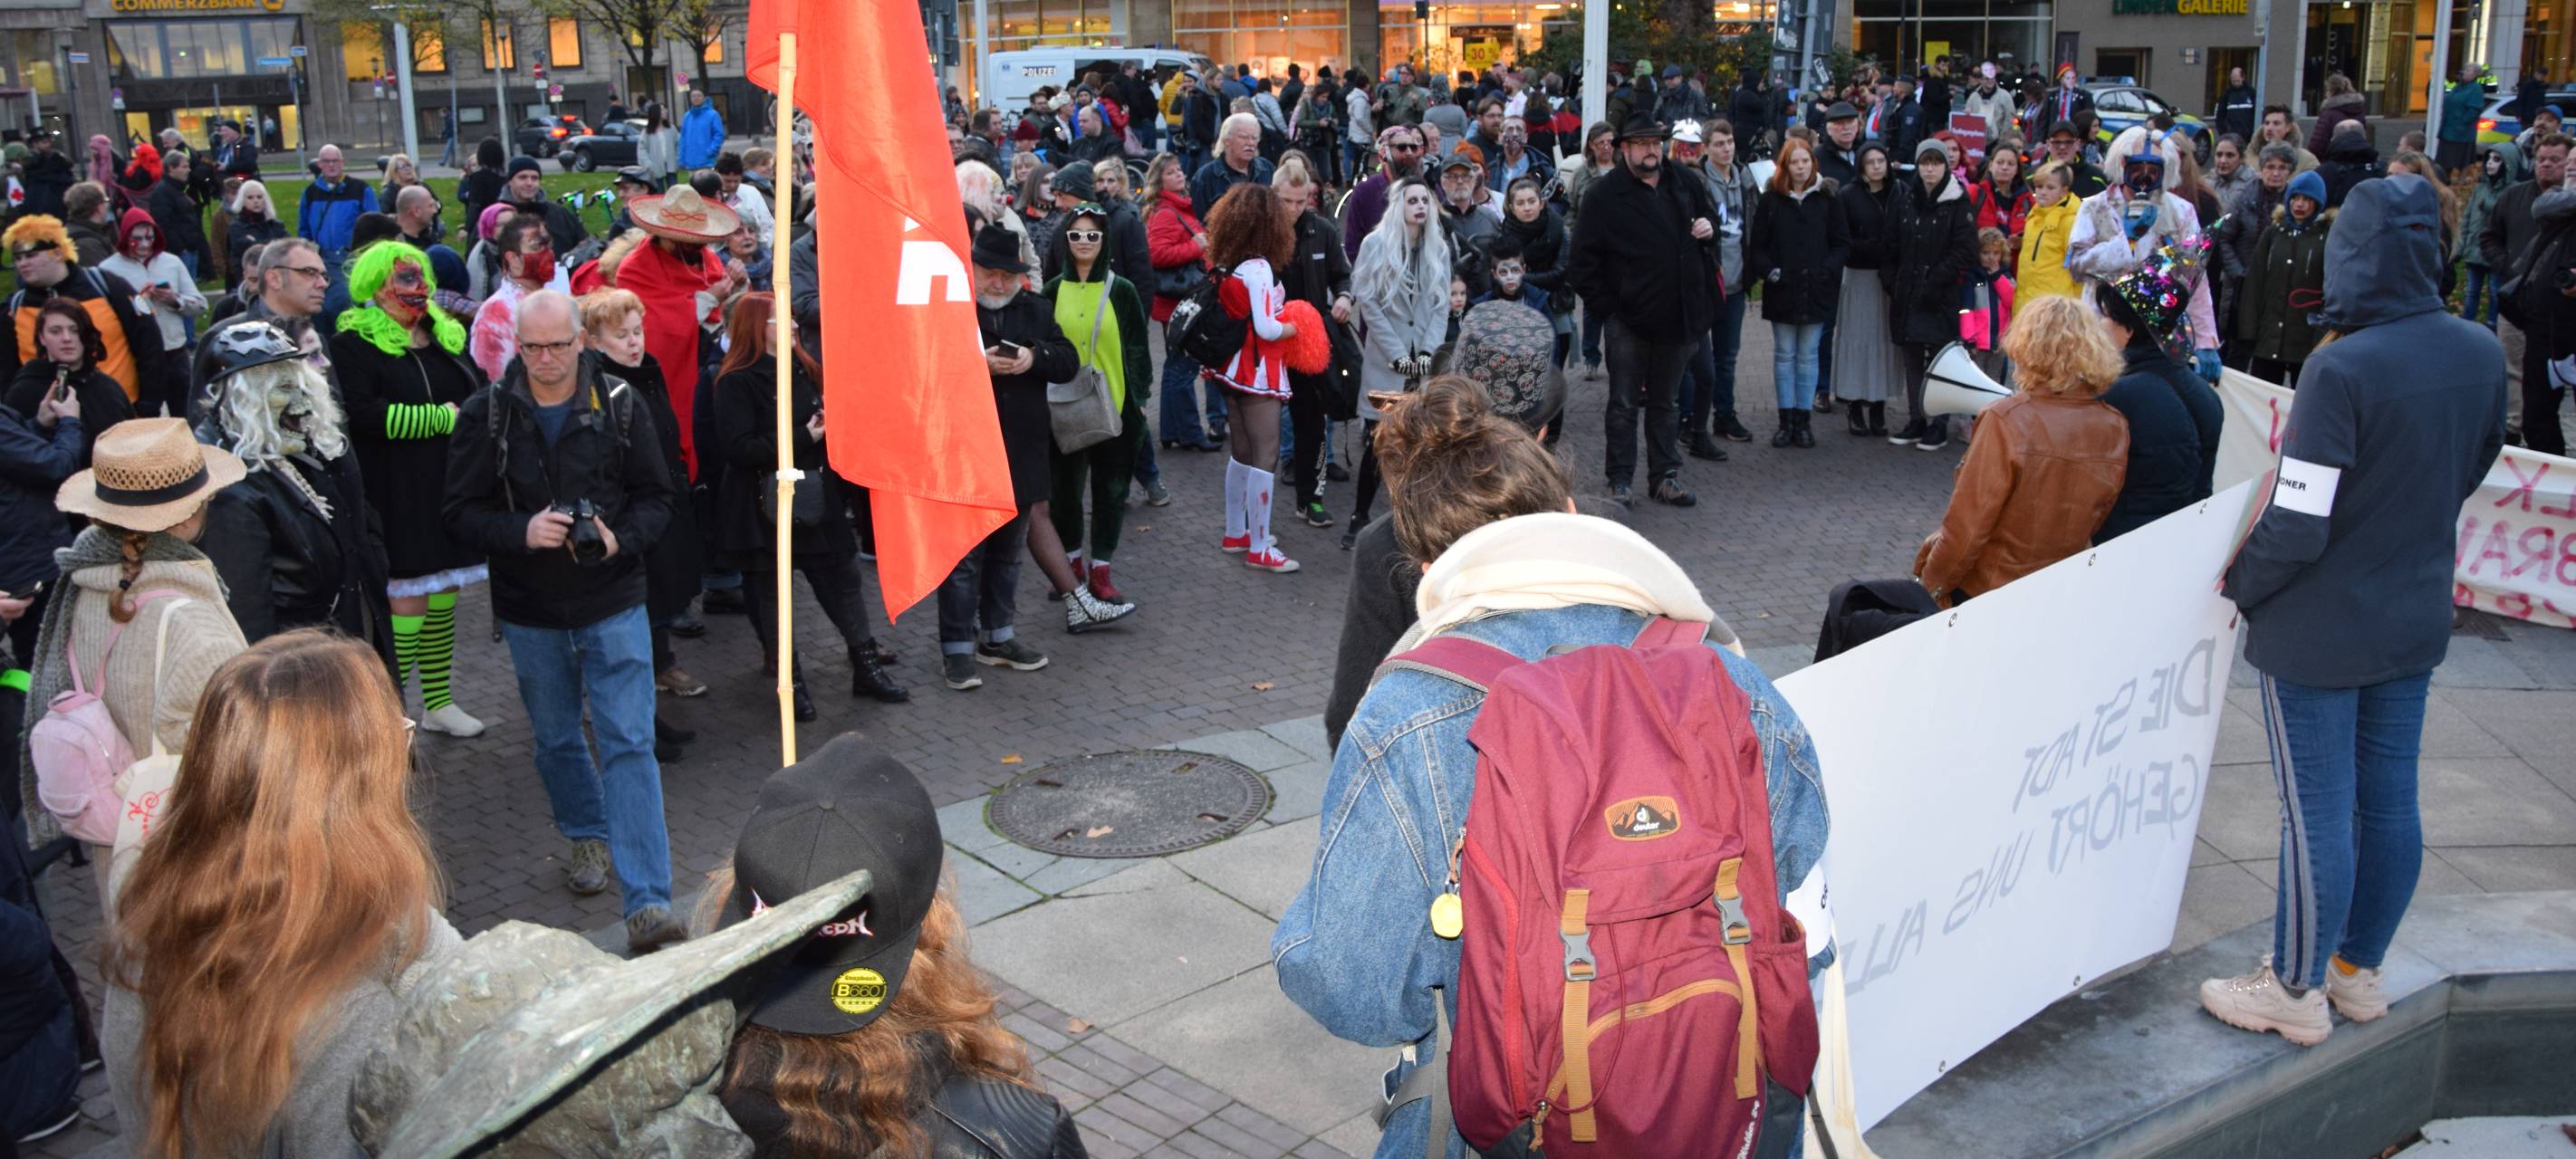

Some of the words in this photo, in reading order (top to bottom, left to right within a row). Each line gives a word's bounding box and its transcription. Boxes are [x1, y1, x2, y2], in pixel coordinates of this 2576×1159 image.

[112, 0, 256, 11] COMMERZBANK
[1023, 65, 1057, 77] POLIZEI
[837, 984, 880, 997] B660
